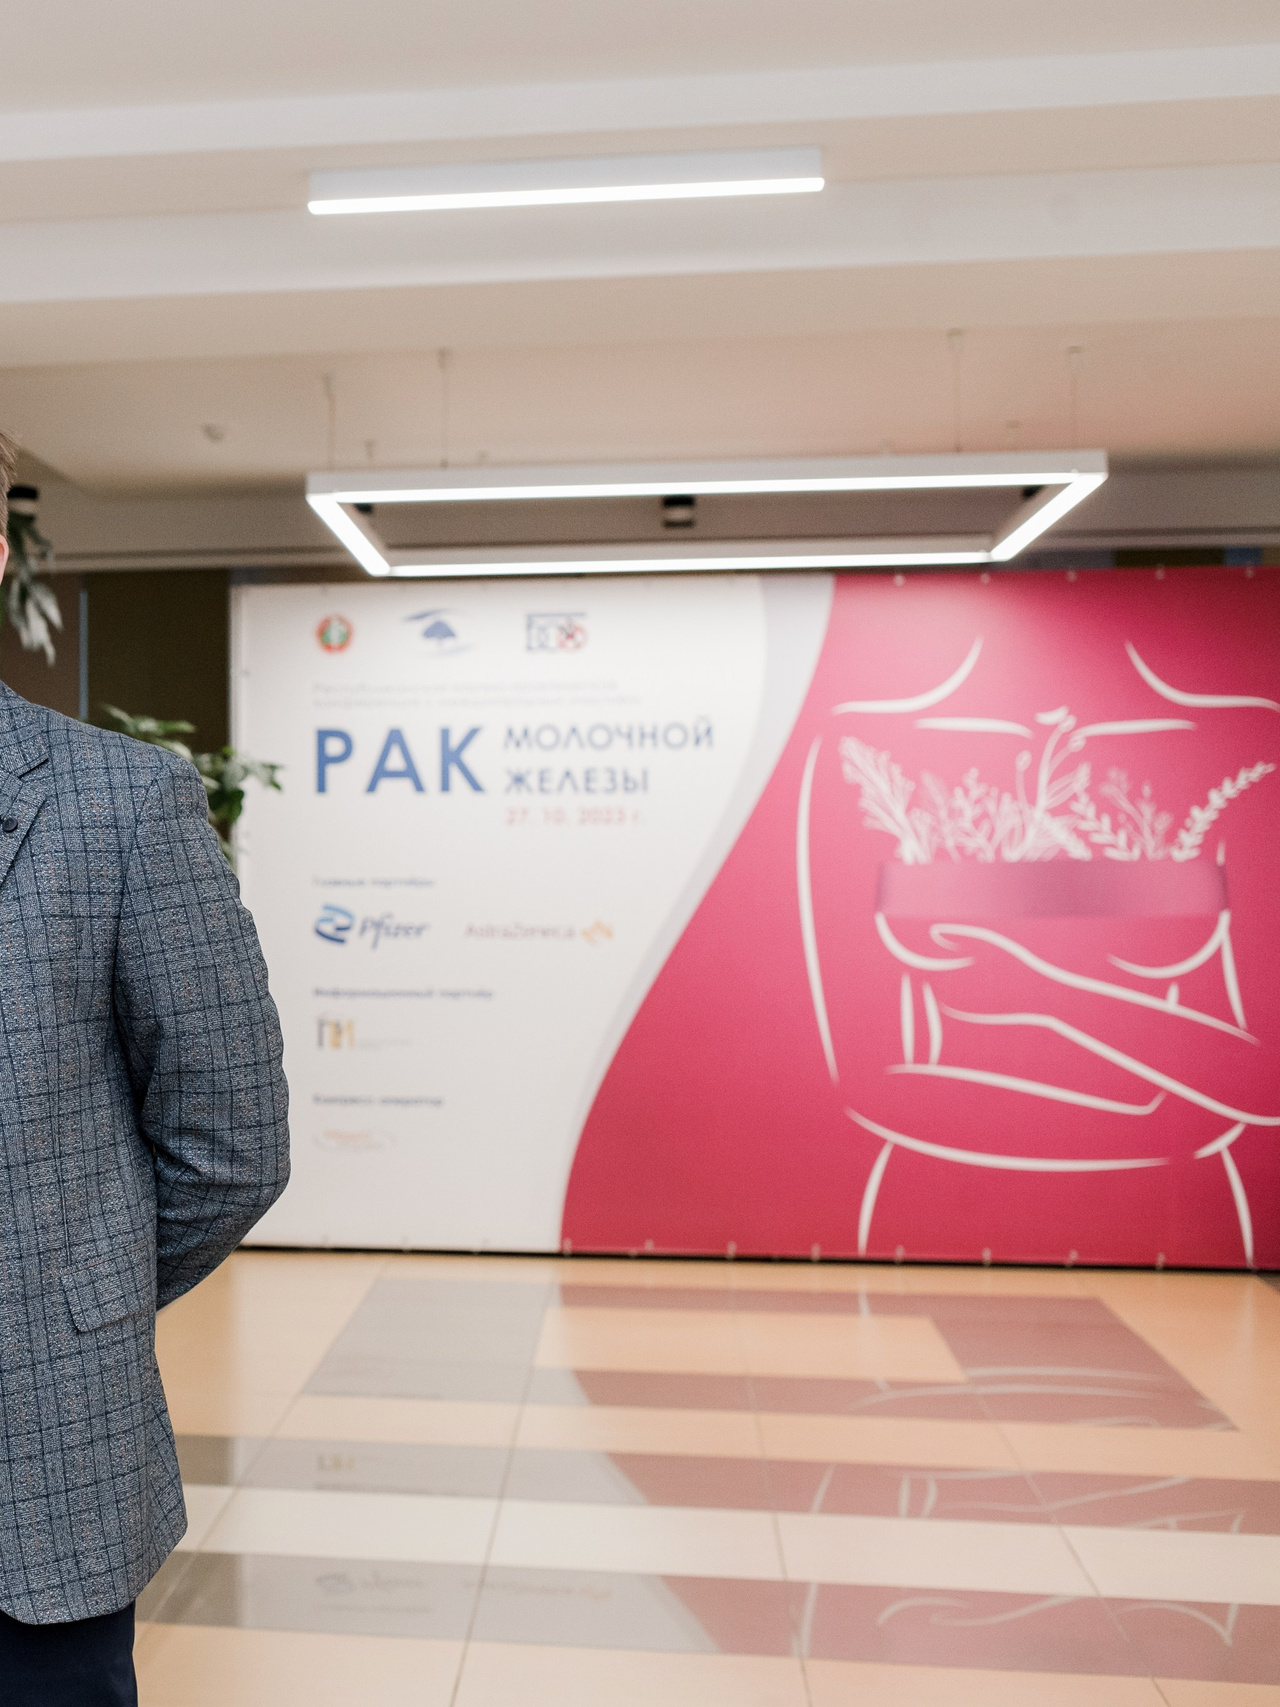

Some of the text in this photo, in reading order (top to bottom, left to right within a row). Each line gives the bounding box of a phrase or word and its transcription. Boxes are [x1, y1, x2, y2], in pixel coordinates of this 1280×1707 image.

[503, 716, 714, 750] МОЛОЧНОЙ
[315, 728, 486, 794] РАК
[504, 767, 650, 795] ЖЕЛЕЗЫ
[359, 912, 430, 951] Pfizer
